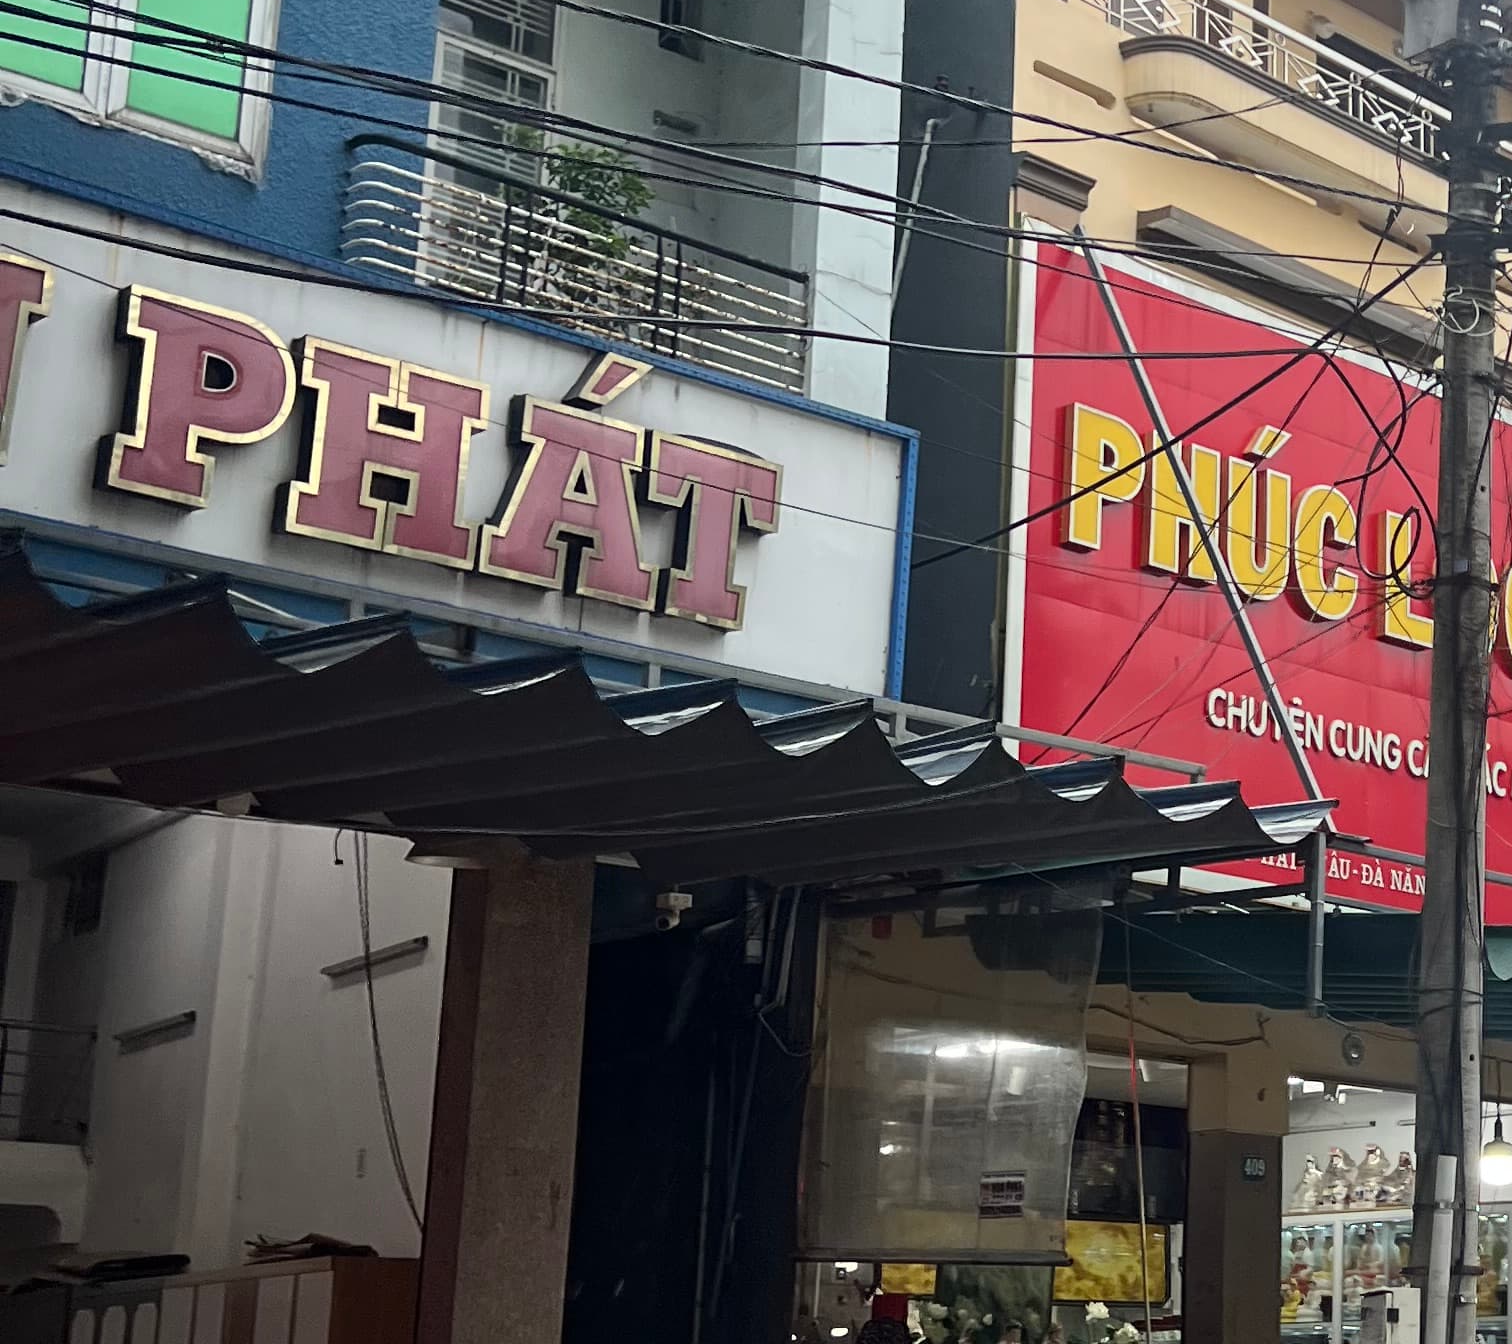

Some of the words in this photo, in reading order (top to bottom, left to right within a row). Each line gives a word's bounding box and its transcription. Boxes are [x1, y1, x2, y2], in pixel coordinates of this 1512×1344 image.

[97, 283, 784, 632] PHÁT
[1061, 401, 1359, 622] PHÚC
[1329, 719, 1401, 771] CUNG
